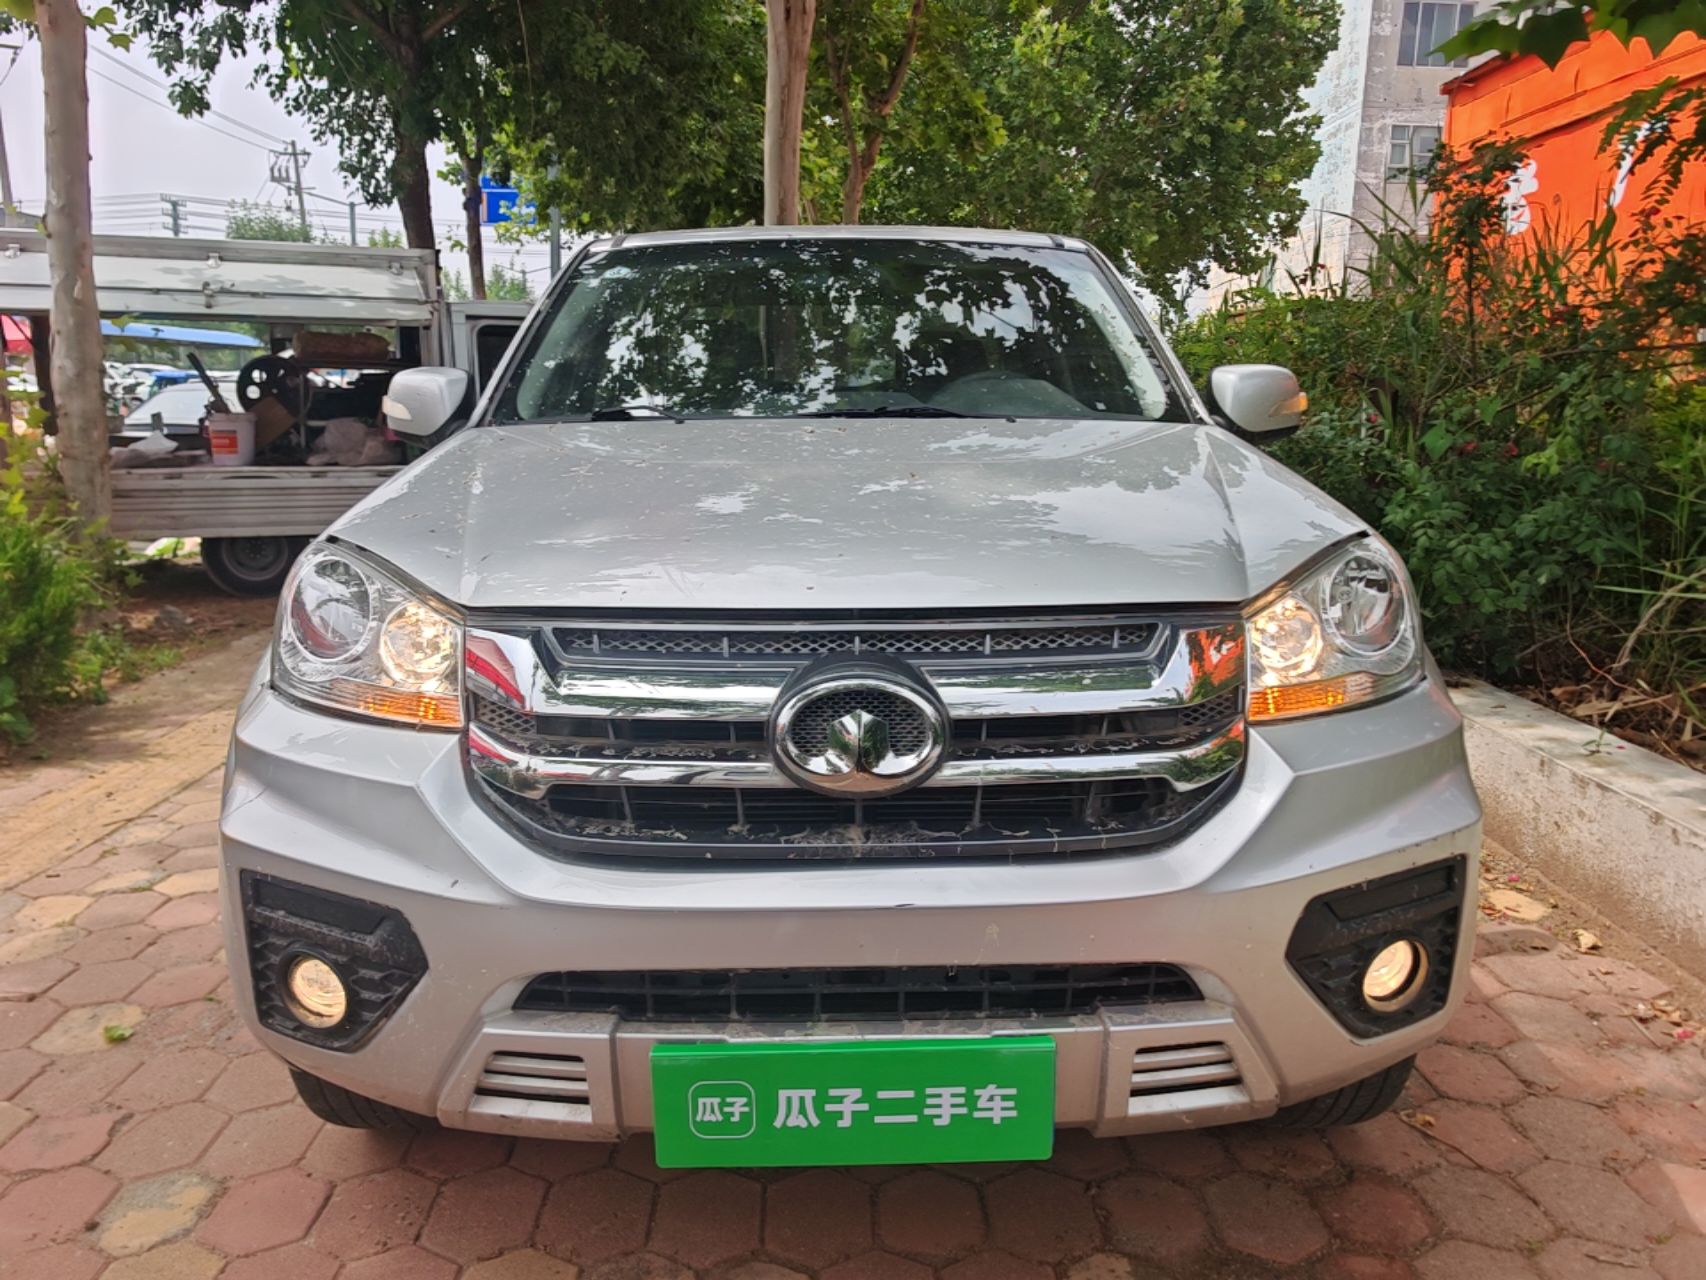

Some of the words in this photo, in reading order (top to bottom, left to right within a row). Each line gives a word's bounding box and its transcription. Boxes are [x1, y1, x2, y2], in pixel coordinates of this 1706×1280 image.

[695, 1096, 750, 1122] 瓜子
[773, 1084, 1018, 1129] 瓜子二手车
